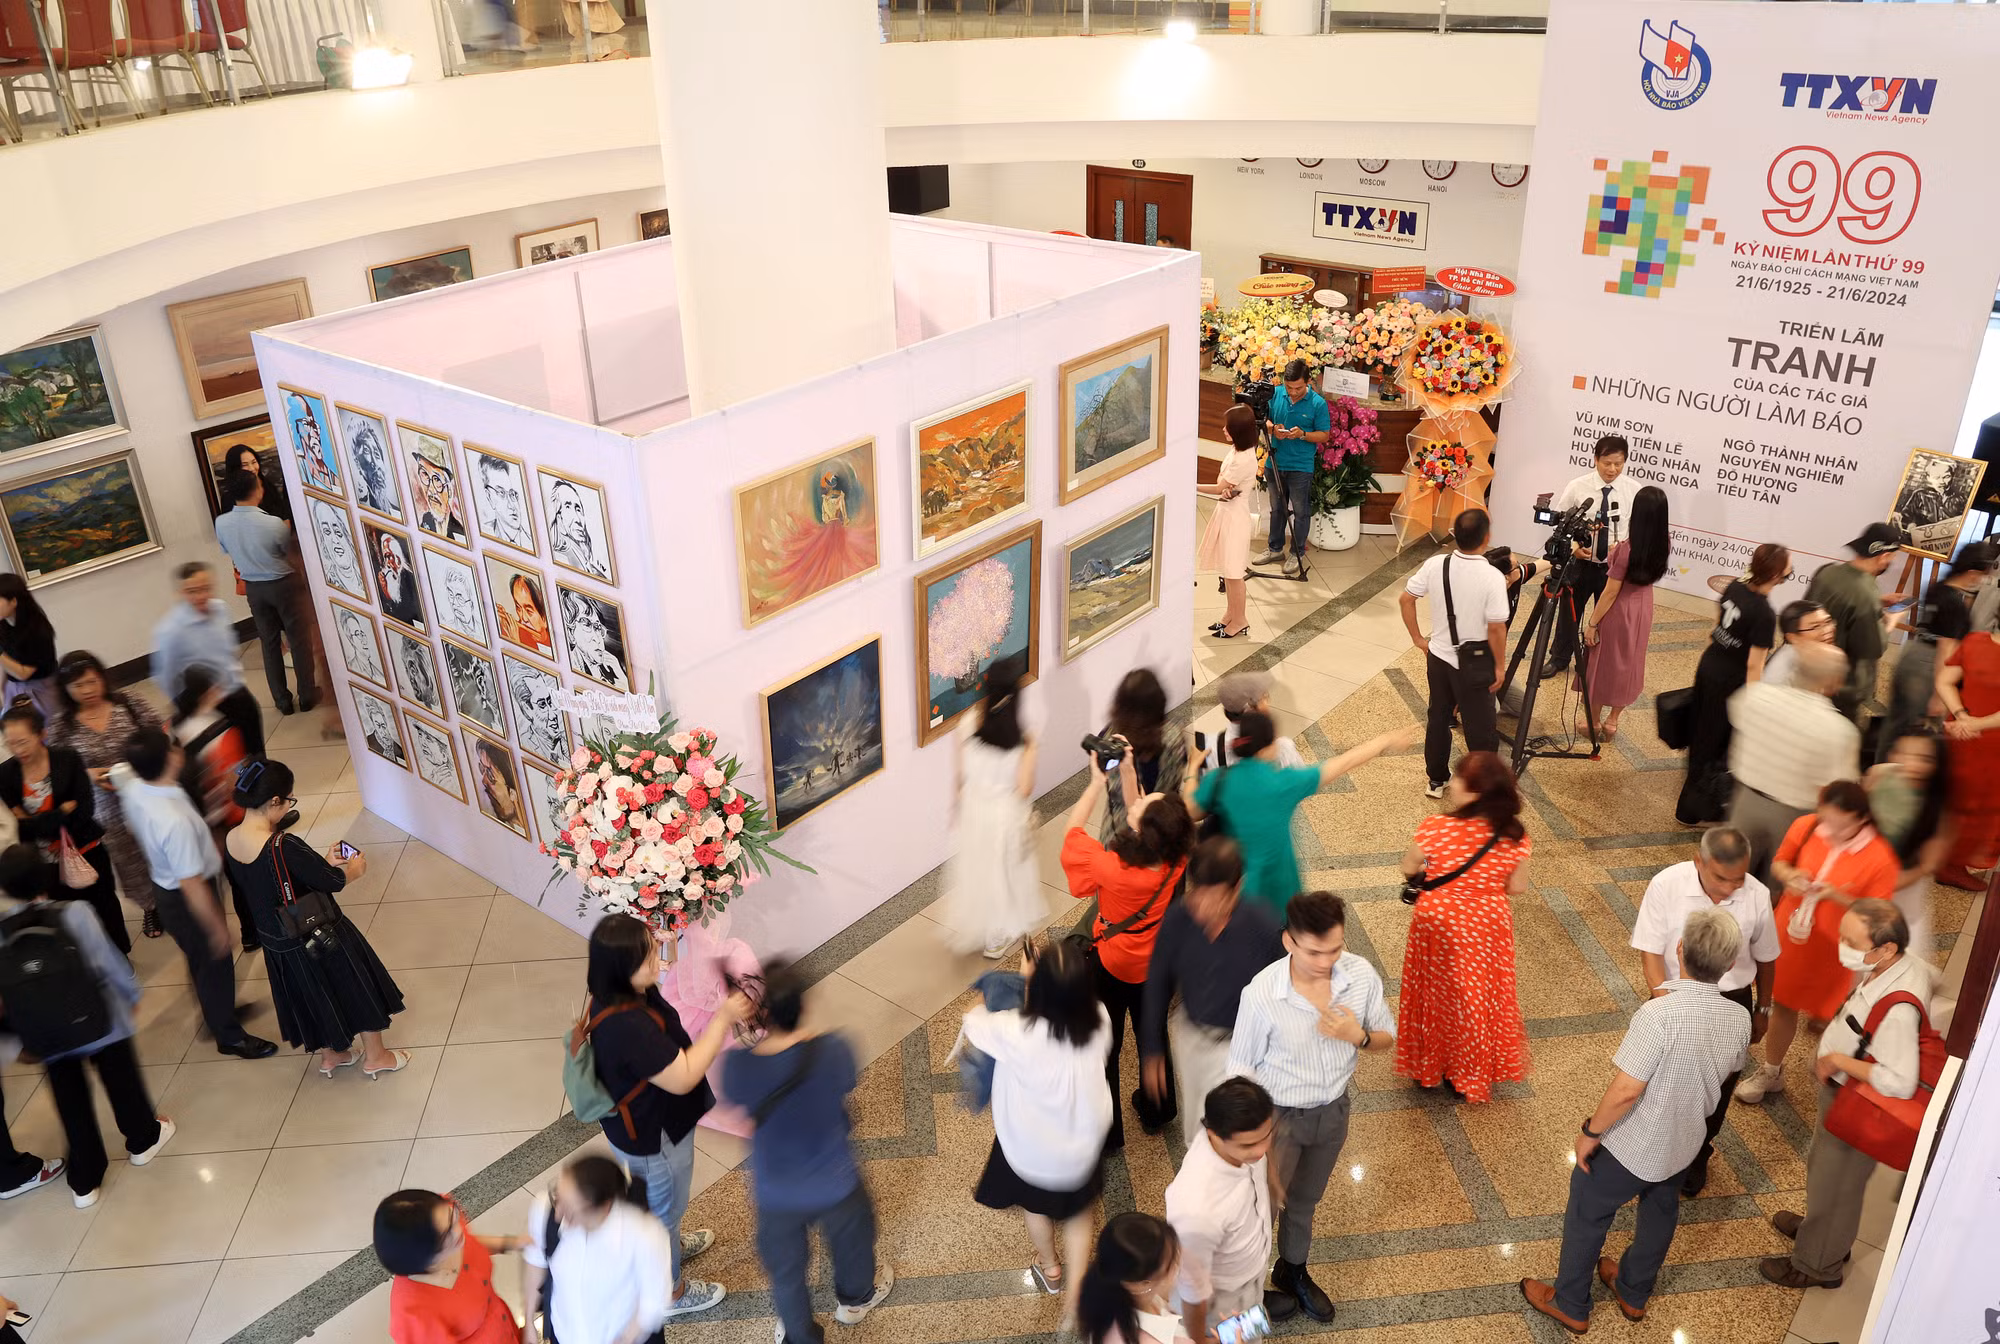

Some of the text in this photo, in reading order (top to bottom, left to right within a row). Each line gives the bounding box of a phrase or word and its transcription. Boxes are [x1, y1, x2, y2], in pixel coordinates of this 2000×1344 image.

[1666, 90, 1679, 98] VJA
[1693, 82, 1706, 98] NAM
[1780, 72, 1938, 114] TTXVN
[1826, 111, 1928, 125] Vietnam News Agency
[1237, 166, 1250, 174] NEW
[1299, 172, 1323, 180] LONDON
[1359, 178, 1386, 186] MOSCOW
[1427, 184, 1447, 192] HANOI
[1762, 145, 1921, 244] 99
[1322, 202, 1417, 235] TTXVN
[1393, 236, 1414, 244] Agency
[1733, 240, 1925, 274] KỶ NIỆM LẦN THỨ 99
[1730, 260, 1919, 288] NGÀY BÁO CHÍ CÁCH MẠNG VIỆT NAM
[1735, 274, 1812, 296] 21/6/1925
[1826, 285, 1907, 307] 21/6/2024
[1778, 320, 1884, 347] TRIỂN LÃM
[1727, 336, 1876, 387] TRANH
[1733, 377, 1868, 409] CỦA CÁC TÁC GIẢ
[1592, 375, 1863, 436] NHỮNG NGƯỜI LÀM BÁO
[1576, 410, 1653, 434] VŨ KIM SƠN
[1571, 441, 1700, 474] HUỲ ŨNG NHÂN
[1723, 438, 1858, 471] NGÔ THÀNH NHÂN
[1626, 466, 1666, 482] HỒNG
[1669, 474, 1699, 489] NGA
[1717, 468, 1798, 492] ĐỖ HƯƠNG
[1720, 453, 1844, 486] NGUYỄN NGHIÊM
[1716, 483, 1781, 504] TIỂU TÂN
[1692, 537, 1719, 550] ngày
[1689, 550, 1714, 564] KHAI,
[283, 882, 292, 900] Canon
